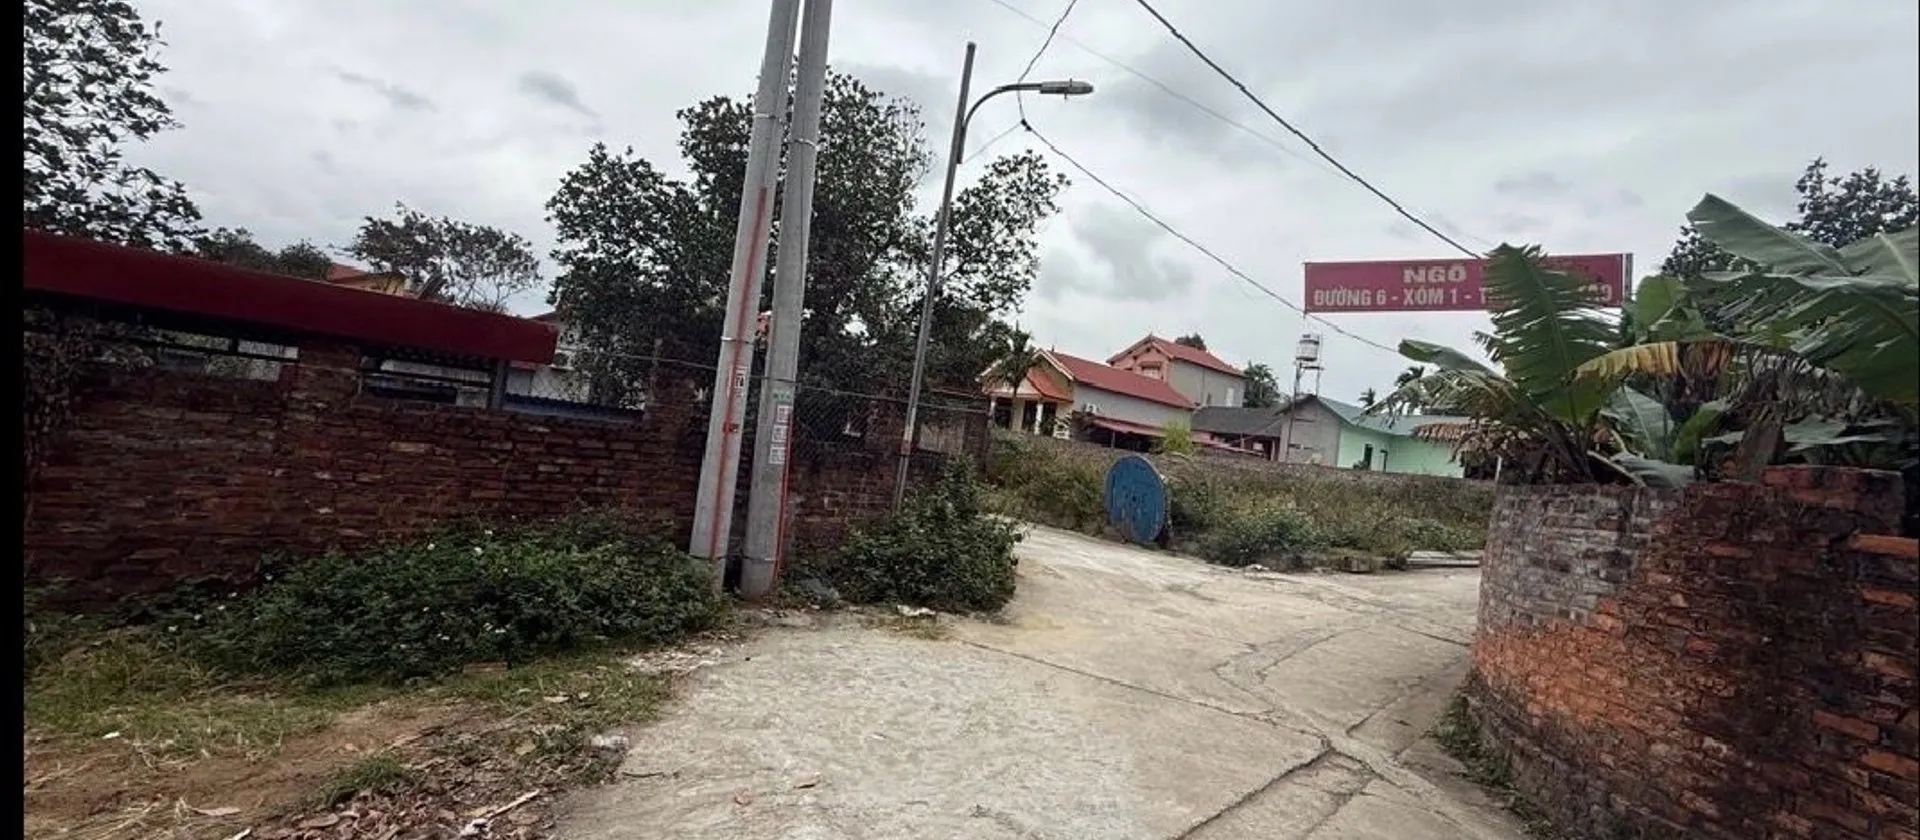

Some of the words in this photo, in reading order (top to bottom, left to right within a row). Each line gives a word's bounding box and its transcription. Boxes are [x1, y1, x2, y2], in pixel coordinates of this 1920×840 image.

[1376, 287, 1387, 306] 6
[1403, 284, 1444, 306] XÓM
[1450, 287, 1457, 305] 1
